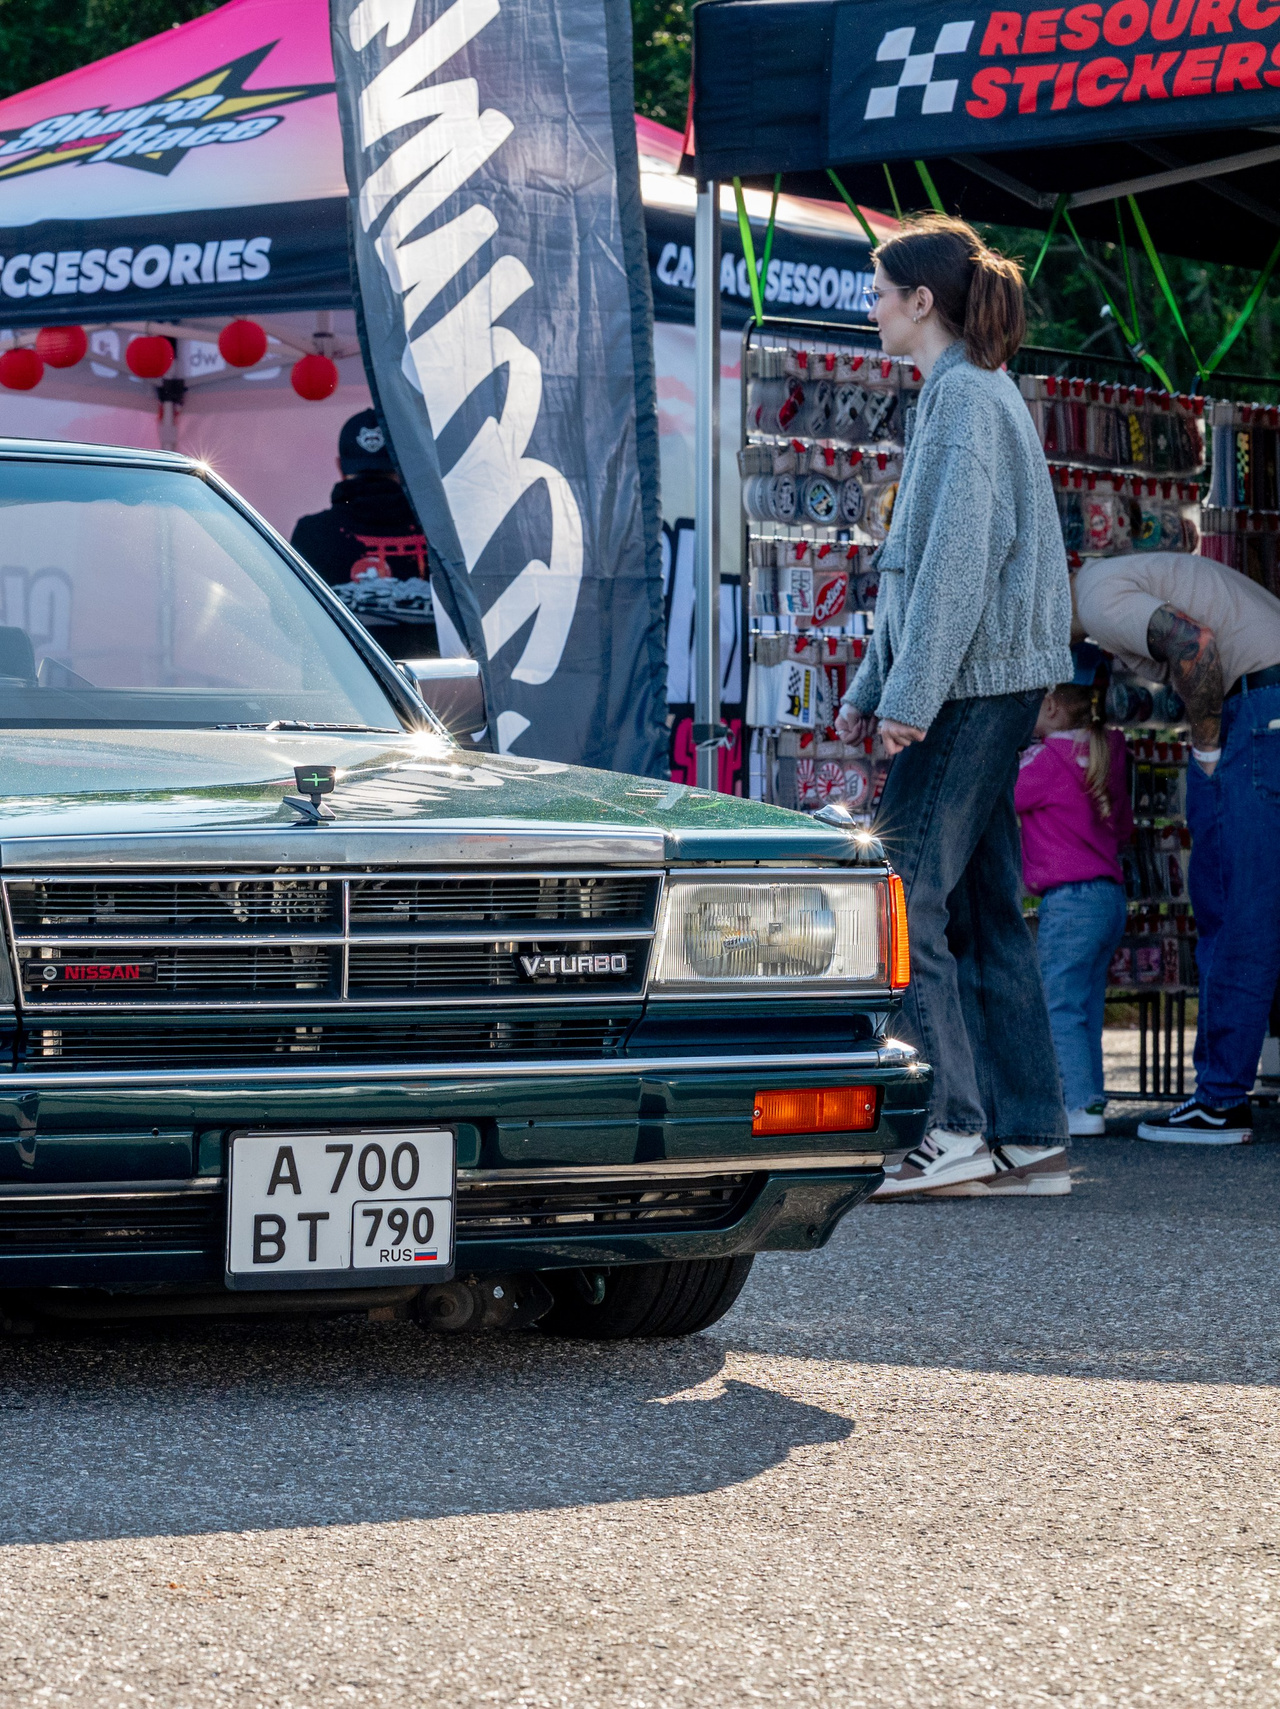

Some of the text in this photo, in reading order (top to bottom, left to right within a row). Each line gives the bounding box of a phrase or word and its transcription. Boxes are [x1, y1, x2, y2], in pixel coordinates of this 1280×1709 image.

[86, 116, 281, 164] Race
[656, 242, 696, 289] CA
[814, 577, 846, 621] Option
[65, 965, 140, 980] NISSAN
[520, 953, 628, 977] V-TURBO
[266, 1141, 420, 1196] A 700
[252, 1206, 434, 1265] BT 790
[379, 1248, 412, 1263] RUS
